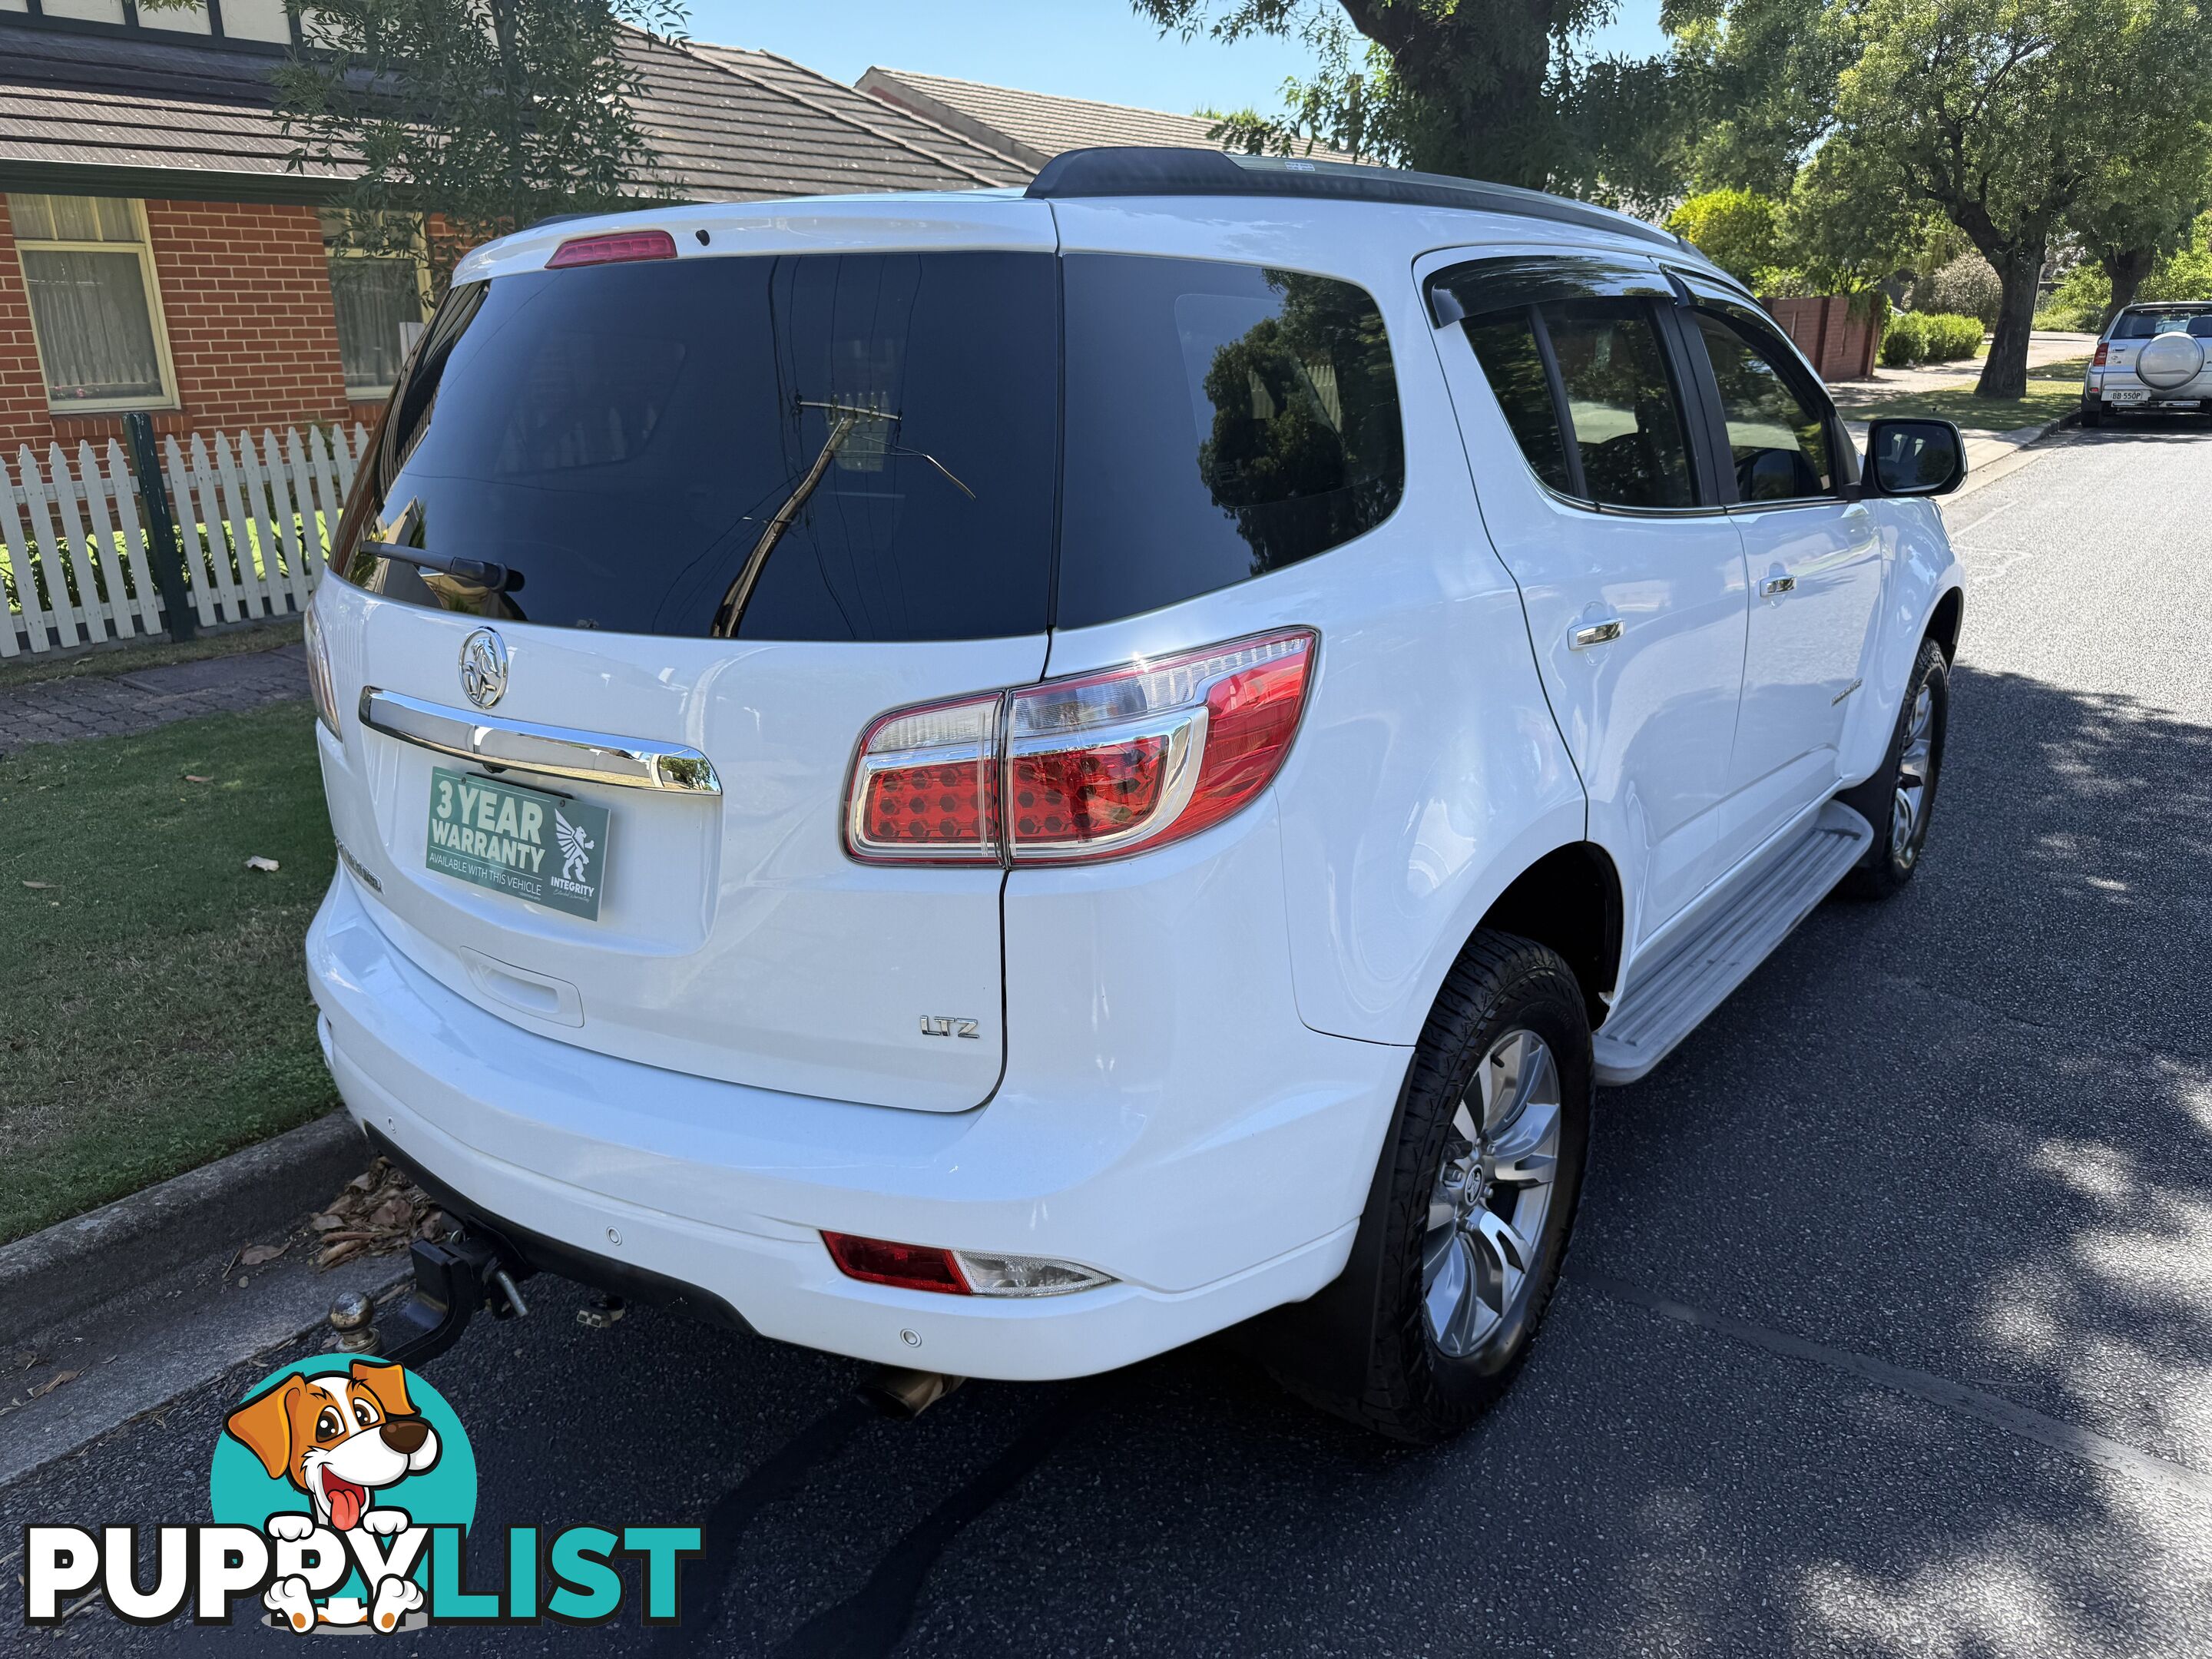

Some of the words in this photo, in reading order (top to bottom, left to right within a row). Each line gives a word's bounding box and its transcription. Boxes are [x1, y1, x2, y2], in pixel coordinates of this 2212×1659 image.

[436, 780, 453, 819] 3
[458, 784, 543, 844] YEAR
[432, 818, 545, 873] WARRANTY
[429, 853, 468, 873] AVAILABLE
[469, 864, 488, 879] WITH
[488, 869, 506, 884] THIS
[507, 876, 542, 896] VEHICLE
[551, 876, 595, 897] INTEGRITY
[920, 1015, 980, 1039] LTZ
